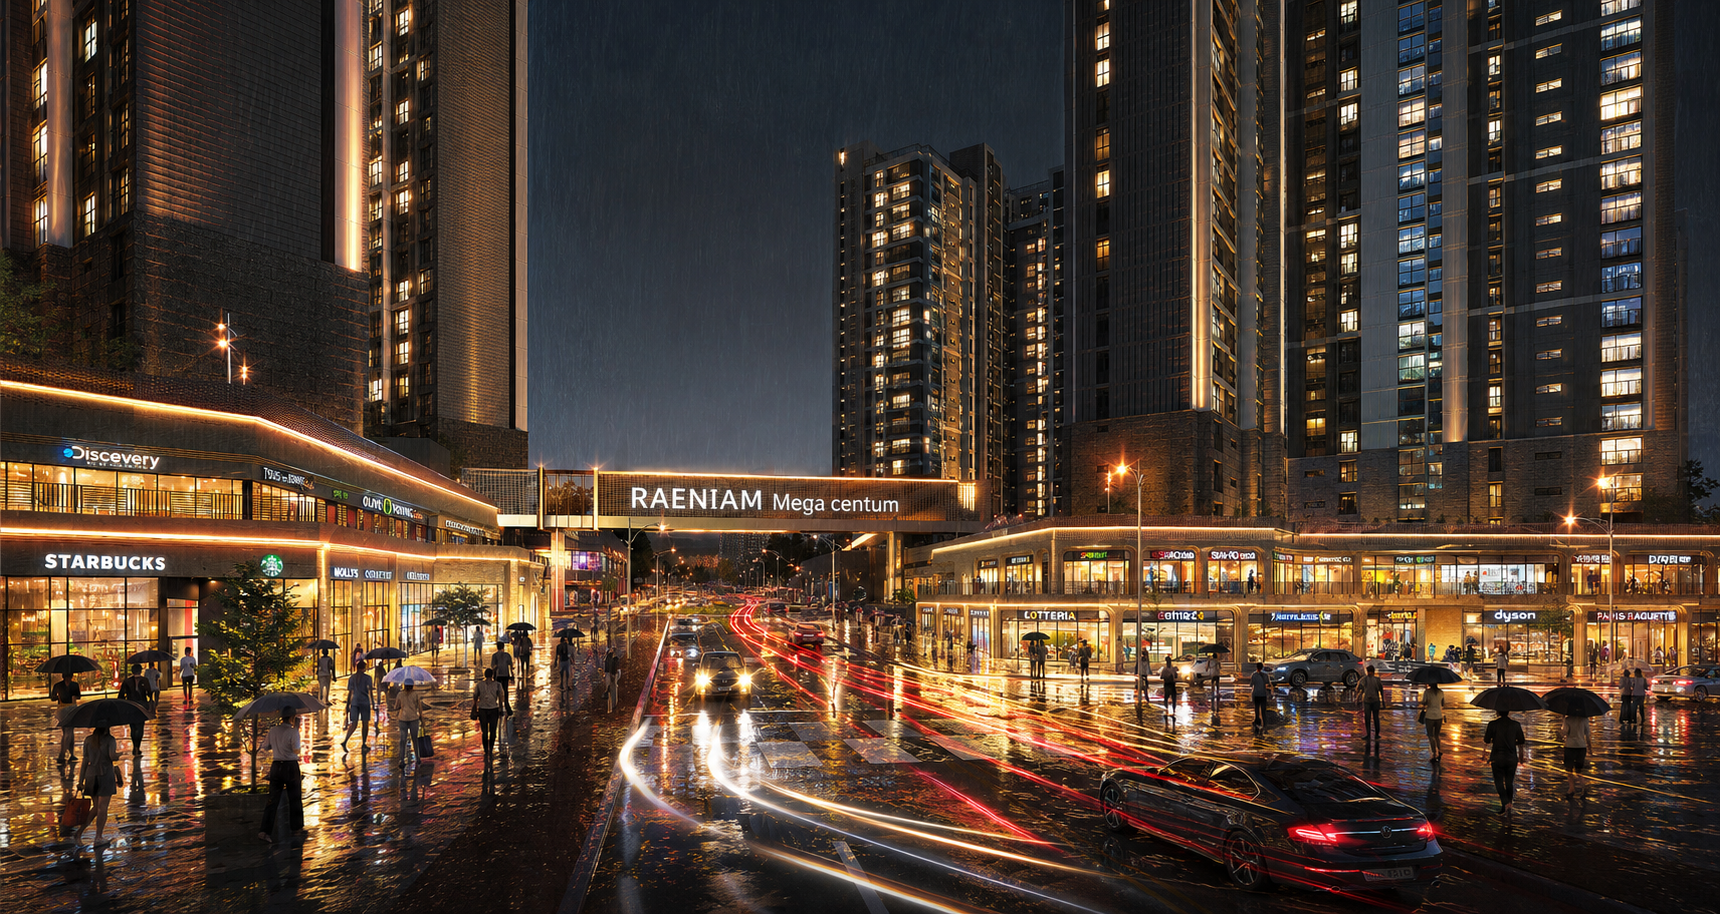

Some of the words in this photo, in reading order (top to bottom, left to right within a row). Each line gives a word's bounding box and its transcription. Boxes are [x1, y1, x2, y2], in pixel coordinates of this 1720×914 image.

[631, 487, 762, 510] RAENIAM
[773, 493, 825, 516] Mega
[831, 496, 899, 512] centum
[44, 554, 166, 571] STARBUCKS
[1024, 611, 1076, 620] LOTTERIA
[1494, 609, 1536, 623] dyson
